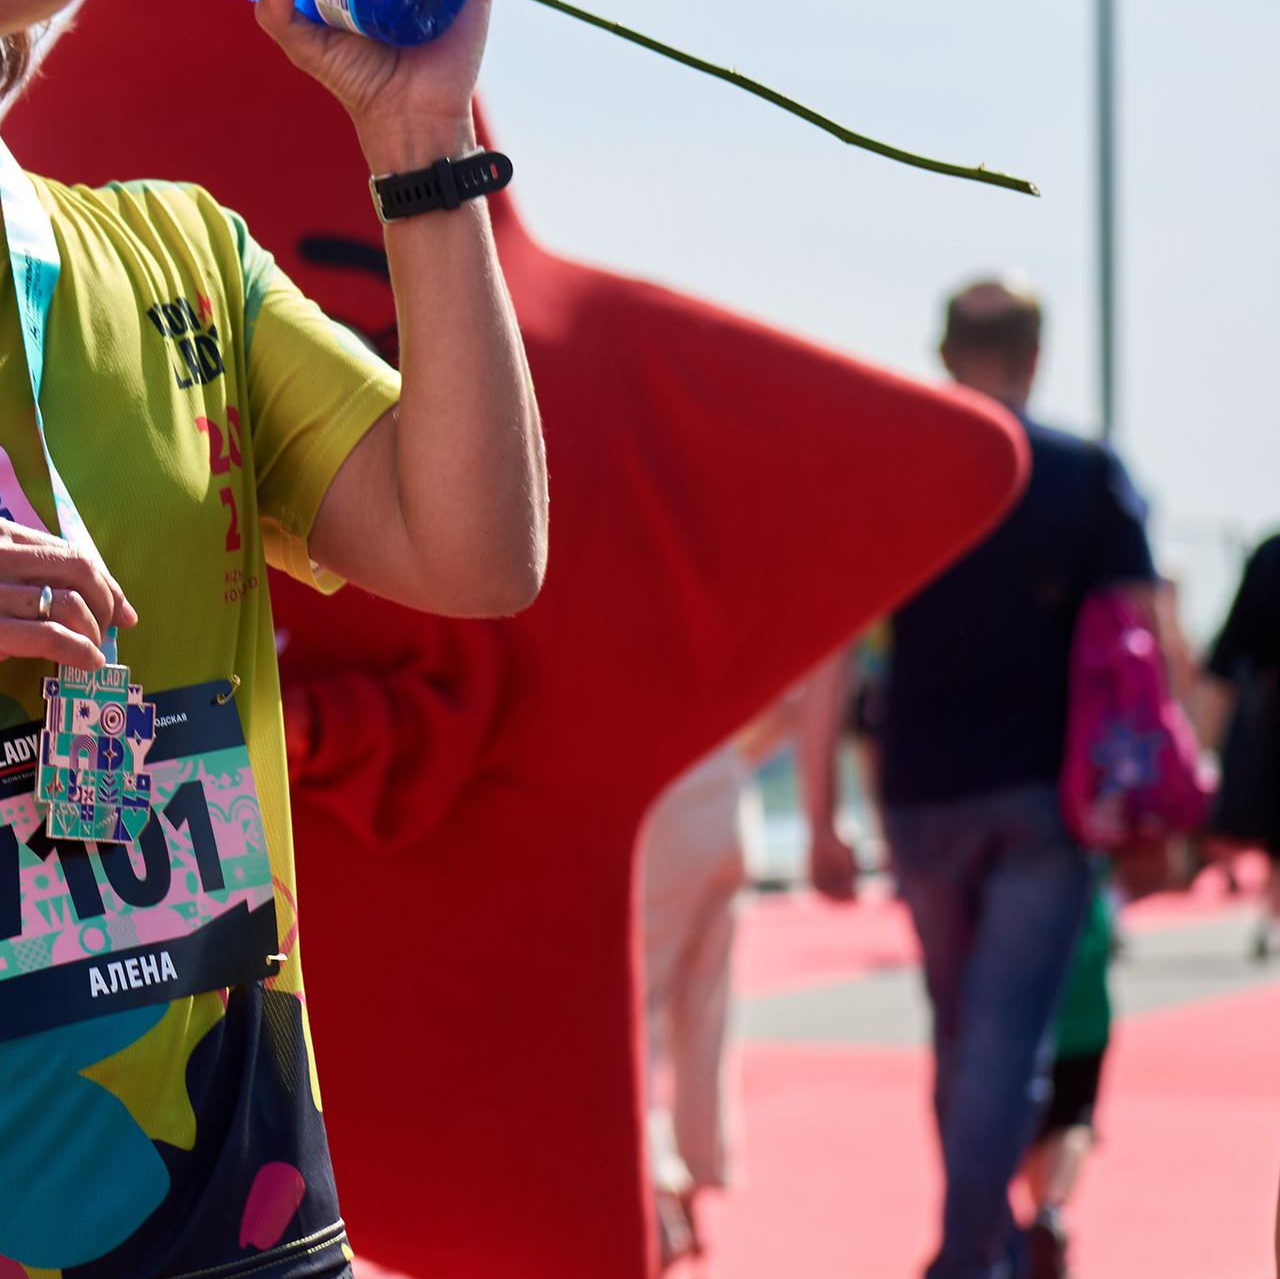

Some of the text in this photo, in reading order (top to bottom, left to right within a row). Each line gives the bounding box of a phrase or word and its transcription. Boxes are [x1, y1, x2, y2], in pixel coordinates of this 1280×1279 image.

[100, 668, 126, 687] LADY
[49, 697, 154, 740] IRON
[88, 951, 178, 997] АЛЕНА
